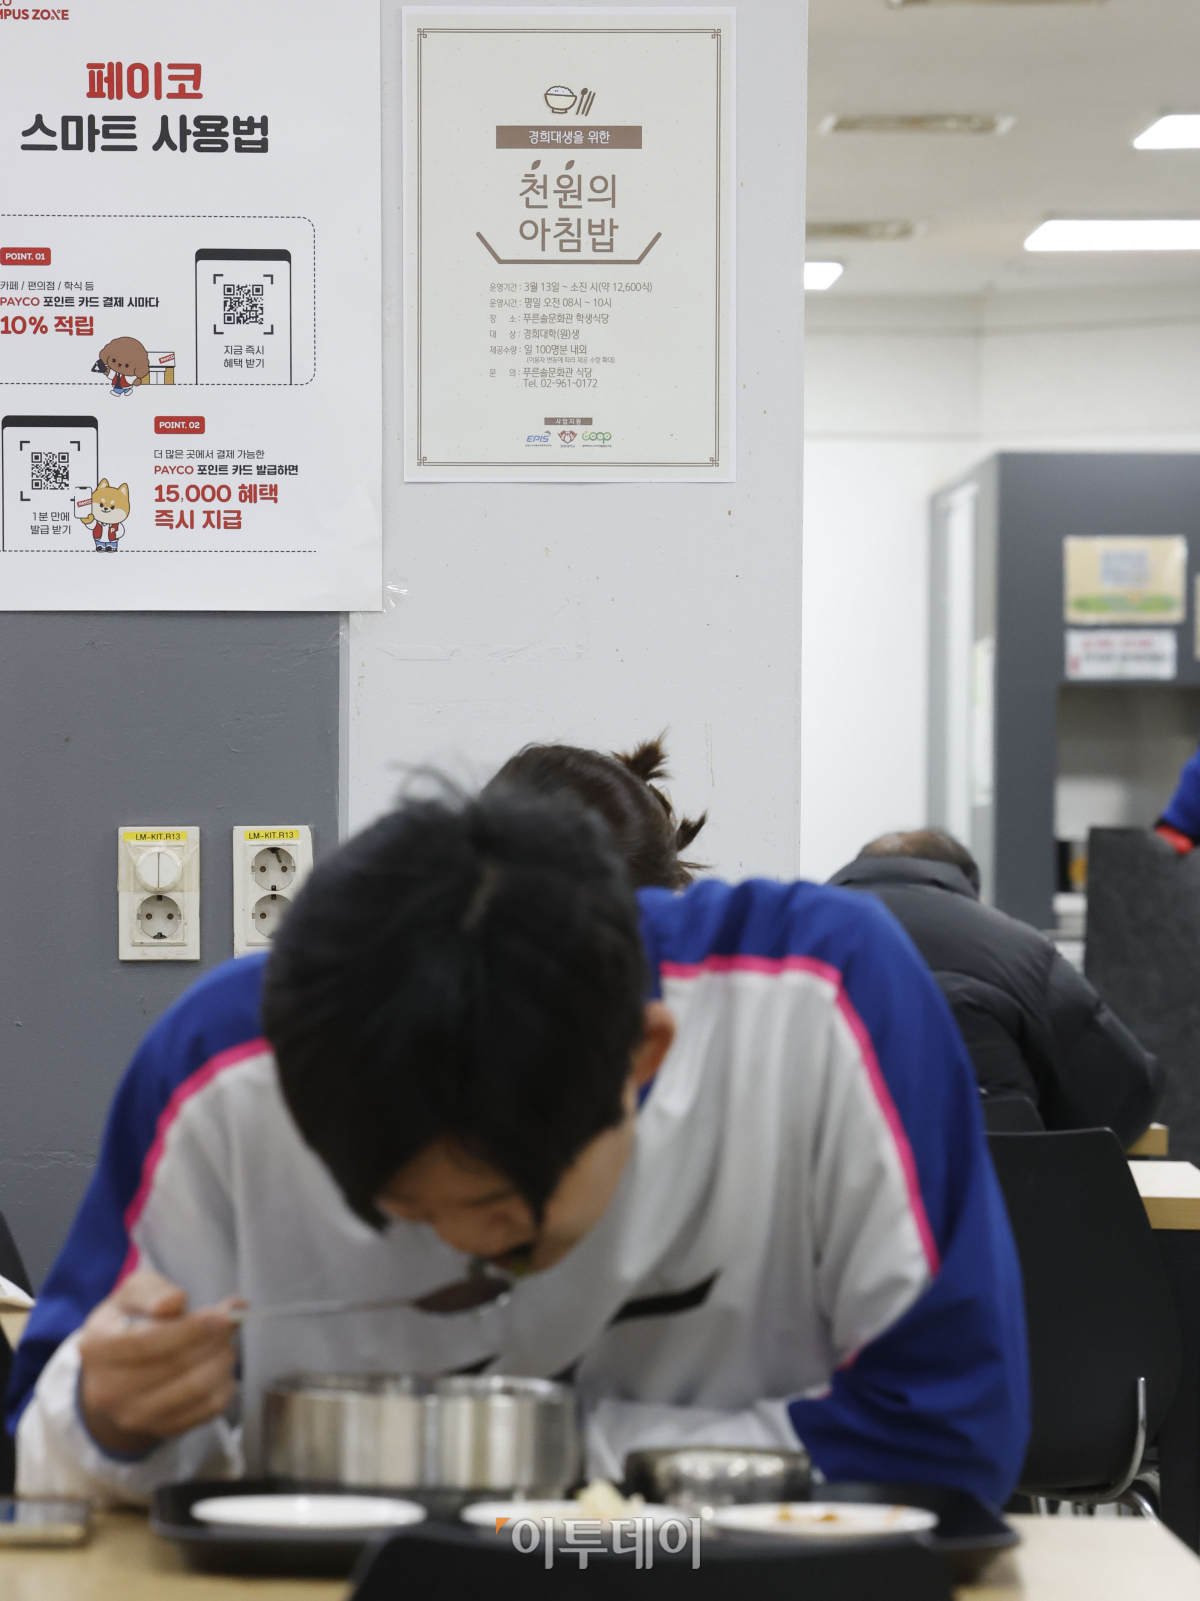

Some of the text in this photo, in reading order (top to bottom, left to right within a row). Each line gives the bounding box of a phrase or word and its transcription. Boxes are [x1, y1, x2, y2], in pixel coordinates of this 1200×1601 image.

[0, 9, 69, 20] PUS ZONE
[86, 61, 203, 100] 페이코
[20, 114, 268, 153] 스마트 사용법
[528, 130, 610, 144] 경희대생을 위한
[519, 173, 616, 209] 천원의
[519, 217, 619, 252] 아침밥
[5, 252, 46, 261] POINT. 01
[0, 281, 18, 291] 카페
[27, 281, 55, 291] 편의점
[64, 281, 83, 291] 학식
[85, 282, 94, 291] 등
[489, 283, 517, 293] 운영기간
[524, 282, 538, 293] 3월
[541, 282, 560, 293] 13일
[570, 282, 587, 293] 소진
[613, 282, 653, 293] 12,600식)
[0, 296, 160, 307] PAYCO 포인트 카드 결제 시마다
[489, 299, 517, 308] 운영시간
[524, 297, 541, 309] 평일
[543, 297, 560, 309] 오전
[562, 297, 582, 308] 08시
[593, 297, 612, 308] 10시
[523, 312, 574, 324] 푸른솔문화관
[576, 312, 610, 325] 학생식당
[0, 316, 94, 336] 10% 적립
[523, 328, 580, 340] 경희대학(원)생
[223, 345, 264, 355] 지금 즉시
[524, 344, 533, 355] 일
[536, 344, 568, 356] 100명분
[570, 344, 587, 355] 내외
[223, 358, 264, 368] 혜택 받기
[523, 366, 573, 378] 푸른솔문화관
[576, 366, 593, 378] 식당
[523, 378, 598, 388] Tel. 02-961-0172
[159, 421, 200, 429] POINT. 02
[526, 435, 550, 443] EPIS
[154, 450, 265, 459] 더 많은 곳에서 결제 가능한
[154, 464, 299, 476] PAYCO 포인트 카드 발급하면
[154, 483, 278, 504] 15,000 혜택
[32, 512, 70, 521] 1분 만에
[155, 509, 242, 530] 즉시 지급
[30, 525, 71, 535] 발급 받기
[135, 833, 181, 841] LM-KIT.R13
[248, 831, 294, 840] LM-KIT.R13
